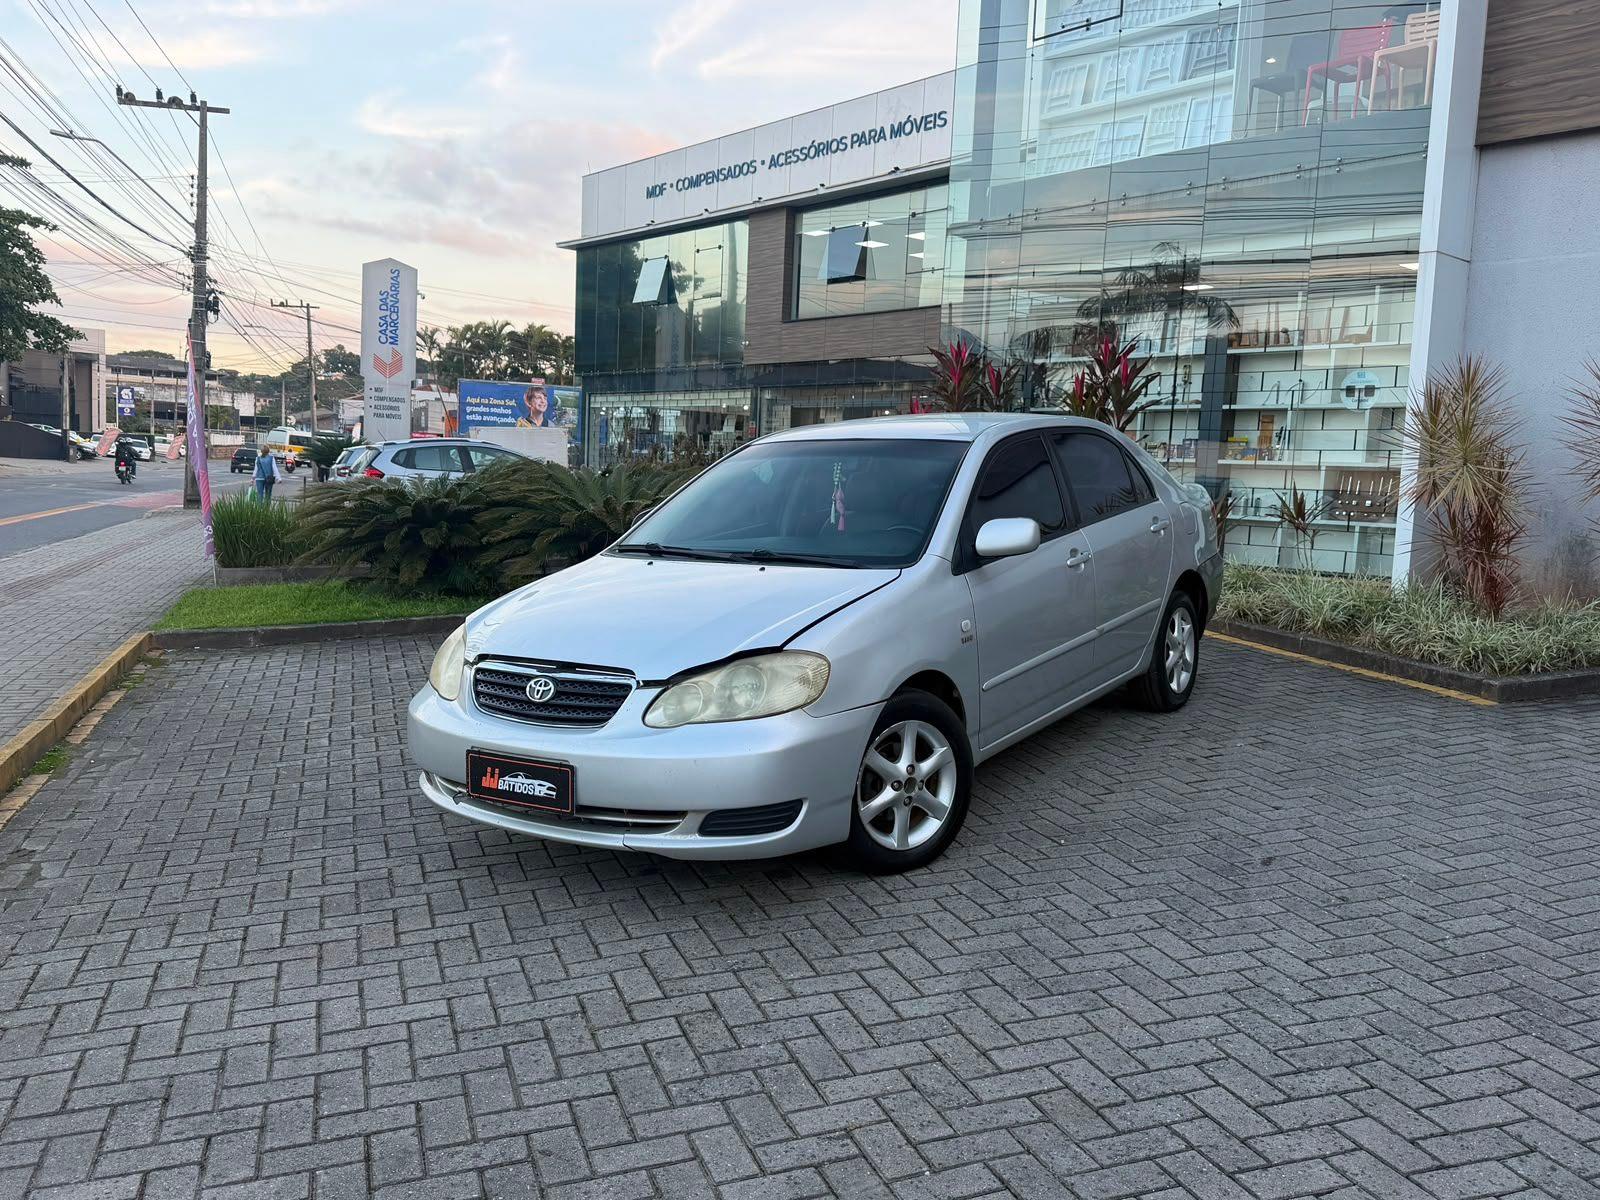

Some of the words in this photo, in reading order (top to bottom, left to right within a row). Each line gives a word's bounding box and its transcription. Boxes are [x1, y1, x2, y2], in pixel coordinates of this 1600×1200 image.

[646, 182, 667, 199] MDF
[675, 159, 757, 192] COMPENSADOS
[768, 136, 848, 170] ACESSÓRIOS
[850, 126, 887, 149] PARA
[889, 110, 948, 140] MÓVEIS
[379, 289, 390, 312] DAS
[388, 268, 401, 346] MARCENARIAS
[378, 314, 389, 345] CASA
[466, 396, 480, 405] Aqui
[489, 397, 504, 405] Zona
[505, 398, 517, 407] Sul,
[466, 405, 489, 413] grandes
[490, 406, 511, 414] sonhos
[498, 779, 535, 795] BATIDOS
